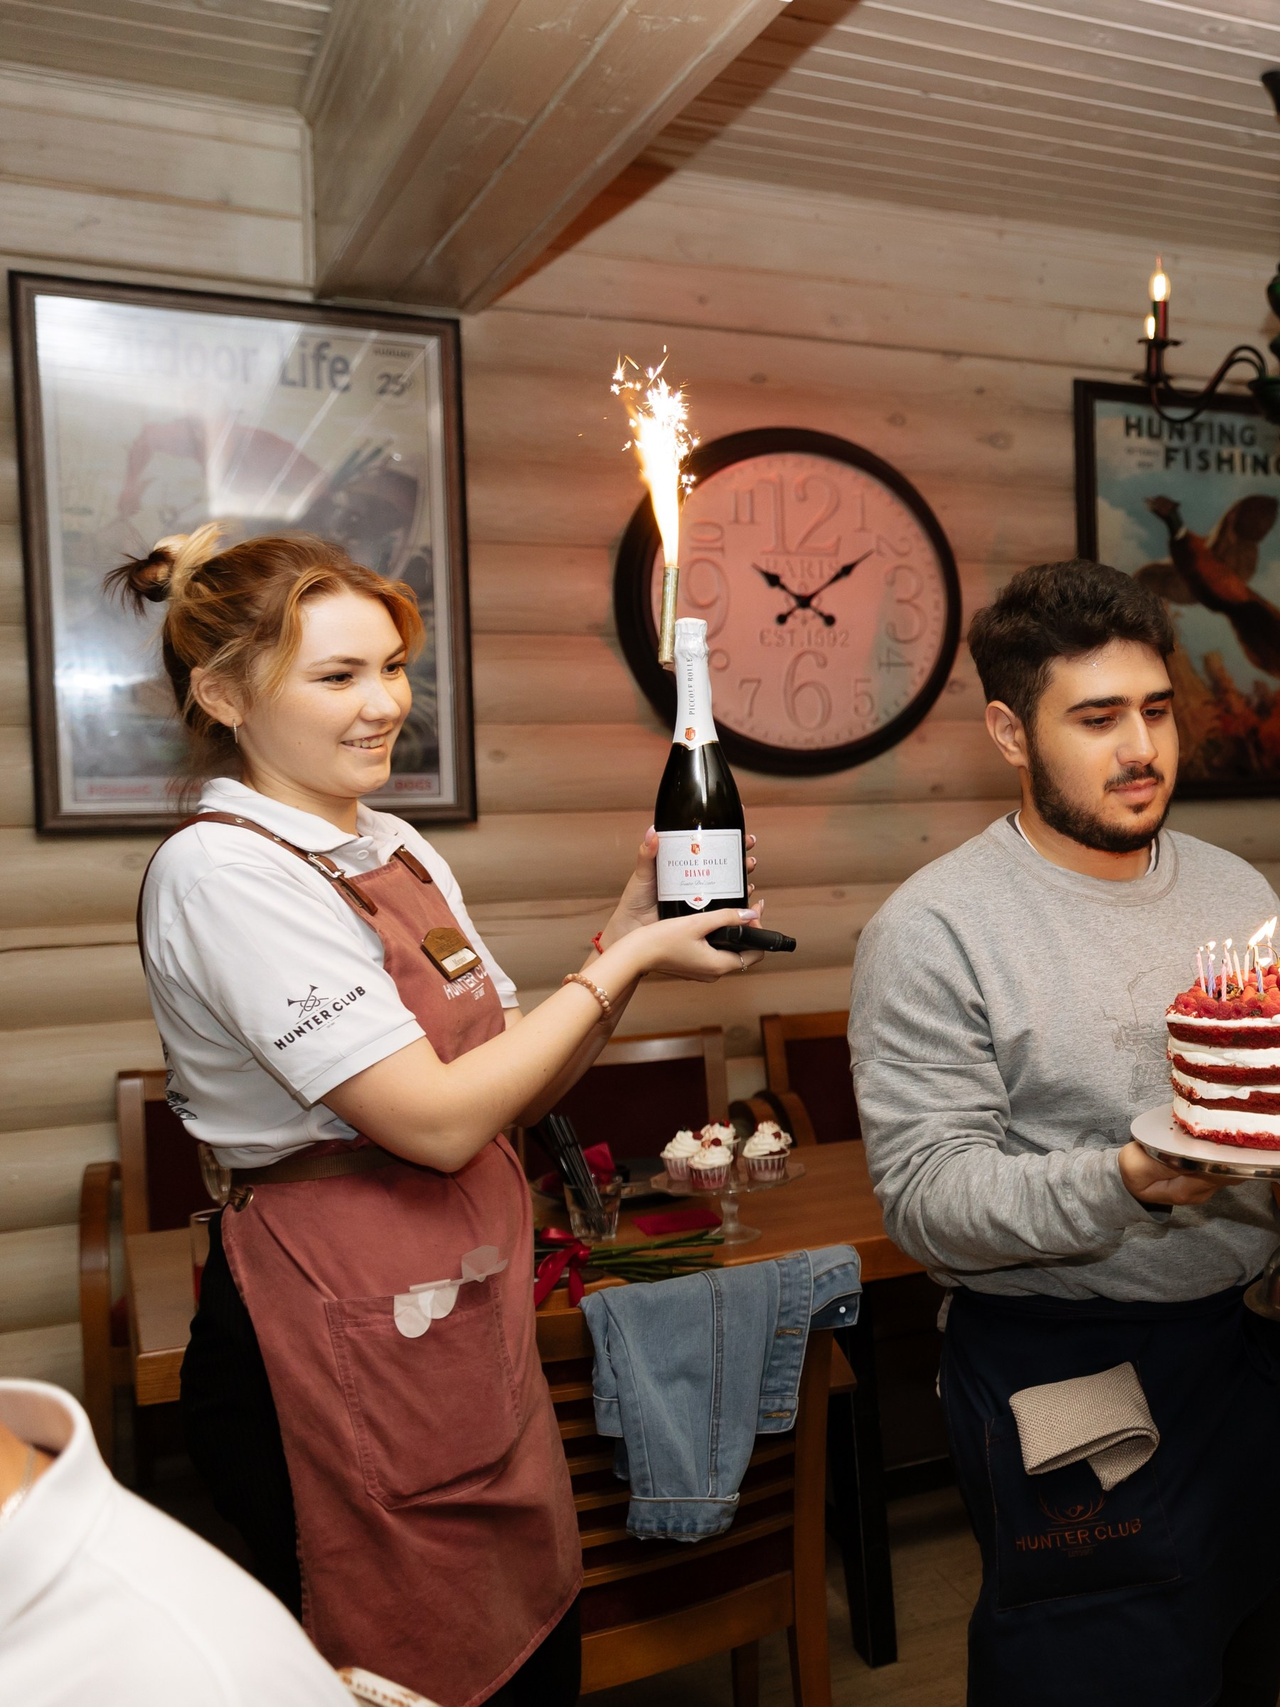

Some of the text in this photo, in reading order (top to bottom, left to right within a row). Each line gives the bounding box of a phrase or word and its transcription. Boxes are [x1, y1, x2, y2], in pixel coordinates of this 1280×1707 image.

[279, 341, 352, 393] Life
[1124, 416, 1258, 447] HUNTING
[756, 472, 843, 557] 12
[684, 557, 731, 642] 9
[884, 564, 929, 646] 3
[876, 646, 915, 675] 4
[738, 677, 763, 719] 7
[783, 649, 834, 732] 6
[852, 677, 877, 718] 5
[684, 869, 711, 878] BIANCO
[443, 971, 480, 1000] HUNTER
[274, 985, 367, 1051] HUNTER CLUB
[1015, 1518, 1142, 1552] HUNTER CLUB
